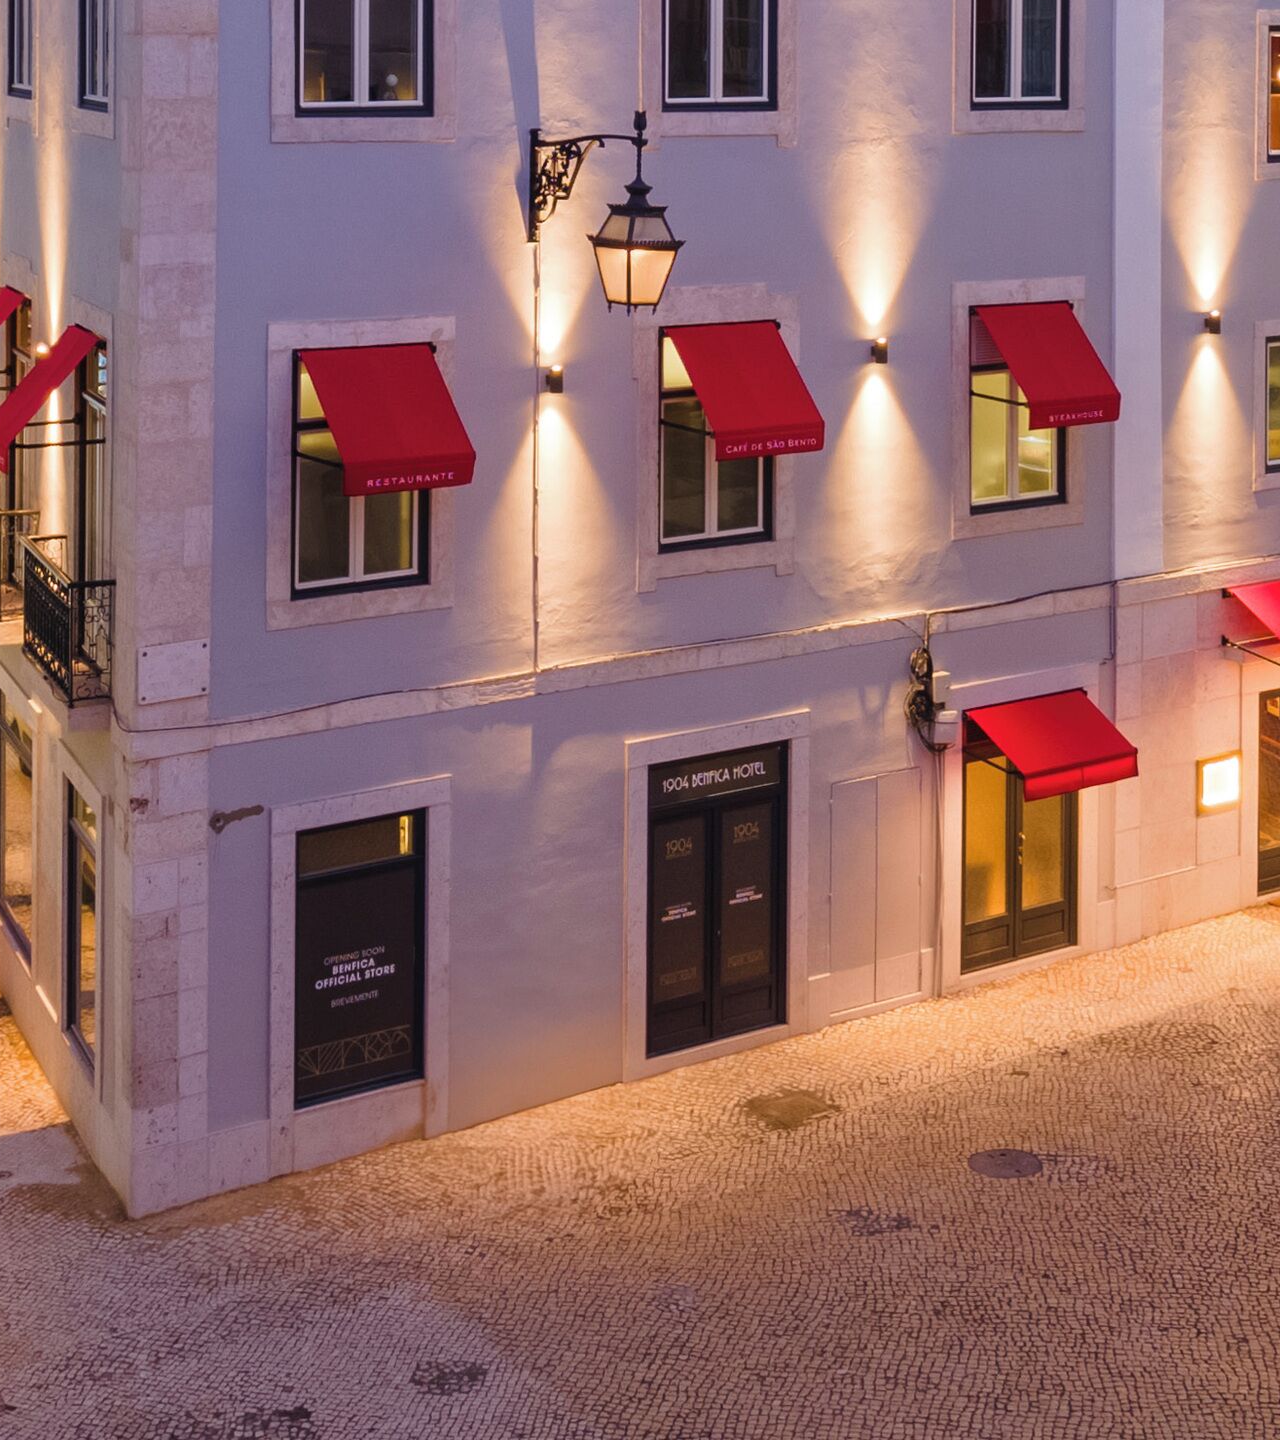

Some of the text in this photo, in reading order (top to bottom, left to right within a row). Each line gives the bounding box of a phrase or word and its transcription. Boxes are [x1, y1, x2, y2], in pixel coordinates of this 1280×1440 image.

[1049, 410, 1103, 422] STEAKHOUSE
[366, 472, 455, 488] RESTAURANTE
[663, 762, 766, 793] 1904 BENFICA HOTEL
[734, 822, 760, 838] 1904
[666, 837, 693, 854] 1904
[323, 945, 385, 966] OPENING SOON
[332, 958, 376, 975] BENFICA
[315, 964, 396, 990] OFFICIAL STORE
[331, 989, 379, 1008] BREVEMENTE
